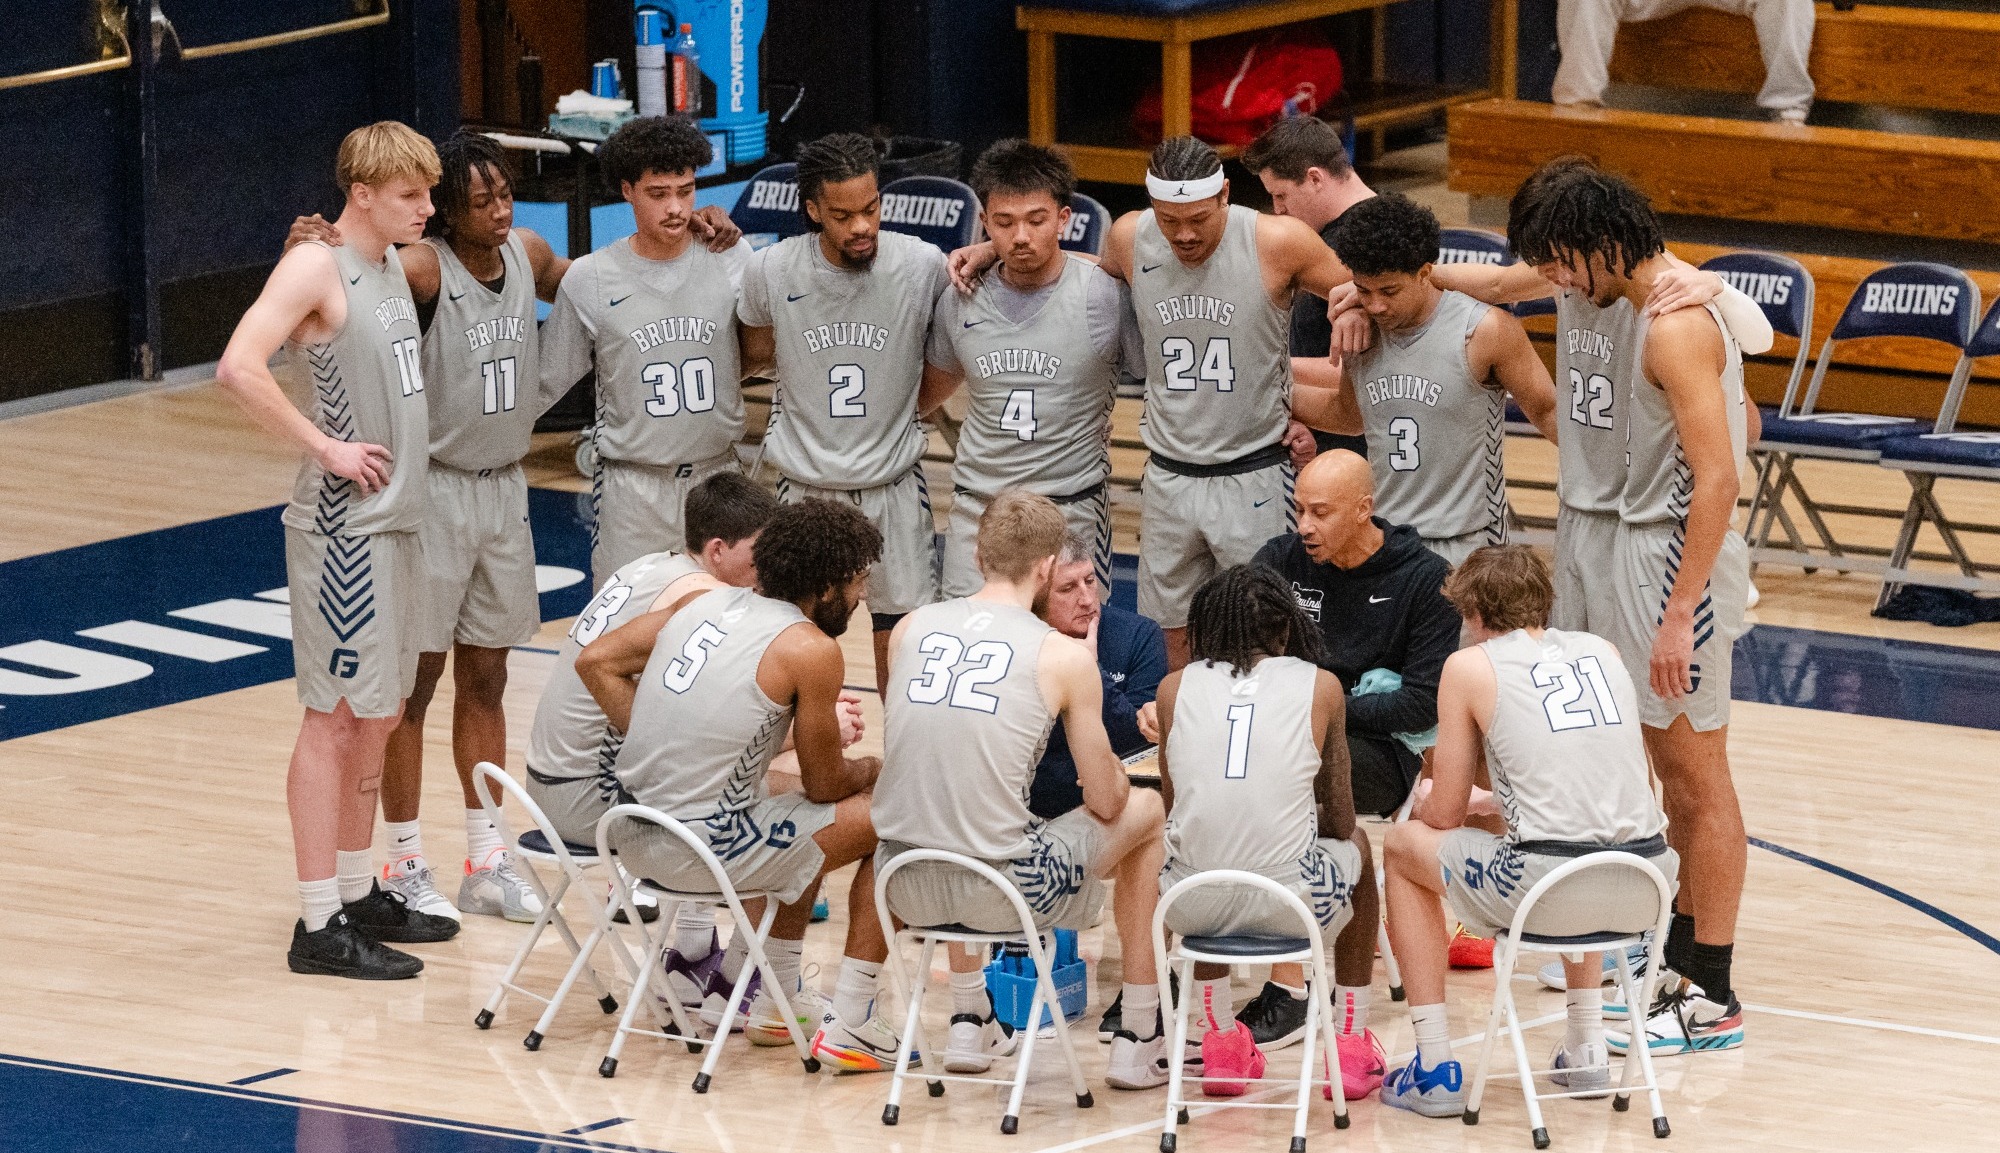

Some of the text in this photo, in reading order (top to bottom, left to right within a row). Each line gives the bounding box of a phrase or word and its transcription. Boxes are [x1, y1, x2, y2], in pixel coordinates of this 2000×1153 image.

[880, 193, 965, 228] BRUINS
[375, 296, 416, 332] BRUINS
[1155, 295, 1236, 327] BRUINS
[1861, 283, 1960, 316] BRUINS
[464, 315, 525, 352] BRUINS
[629, 317, 718, 354] BRUINS
[802, 322, 889, 354] BRUINS
[1567, 327, 1614, 365] BRUINS
[392, 336, 424, 397] 10
[481, 355, 516, 415] 11
[641, 356, 716, 418] 30
[828, 363, 866, 418] 2
[975, 349, 1061, 380] BRUINS
[1161, 336, 1236, 392] 24
[1365, 374, 1443, 407] BRUINS
[1000, 389, 1038, 441] 4
[1569, 366, 1614, 430] 22
[1388, 416, 1421, 472] 3
[568, 574, 632, 647] 13
[663, 620, 728, 695] 5
[907, 632, 1014, 715] 32
[1530, 655, 1622, 733] 21
[1225, 703, 1255, 779] 1
